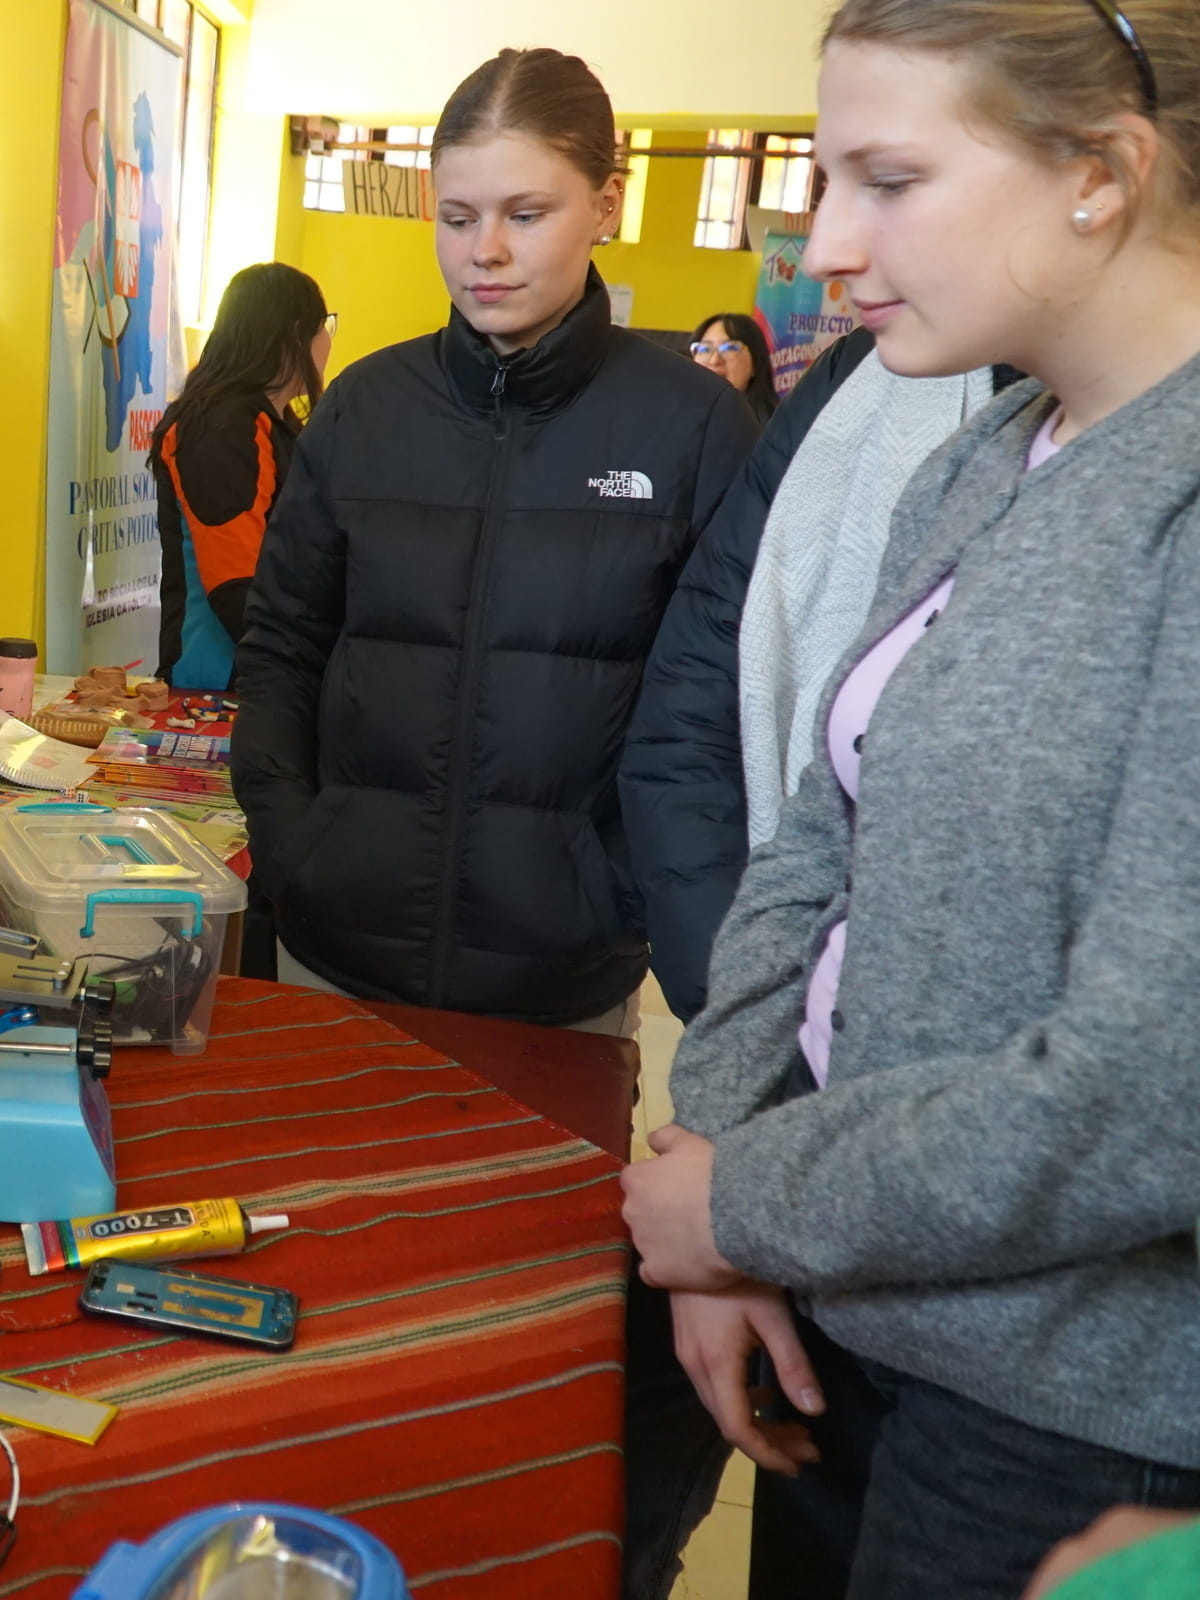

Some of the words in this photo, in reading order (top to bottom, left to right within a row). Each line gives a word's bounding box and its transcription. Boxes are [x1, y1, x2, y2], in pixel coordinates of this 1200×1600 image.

[788, 312, 854, 334] PROYECTO
[129, 409, 162, 451] PASOC
[588, 478, 631, 489] NORTH
[607, 470, 631, 480] THE
[132, 471, 158, 503] SOCI
[600, 487, 631, 497] FACE
[77, 519, 125, 560] CRITAS
[94, 1211, 189, 1236] T-7000
